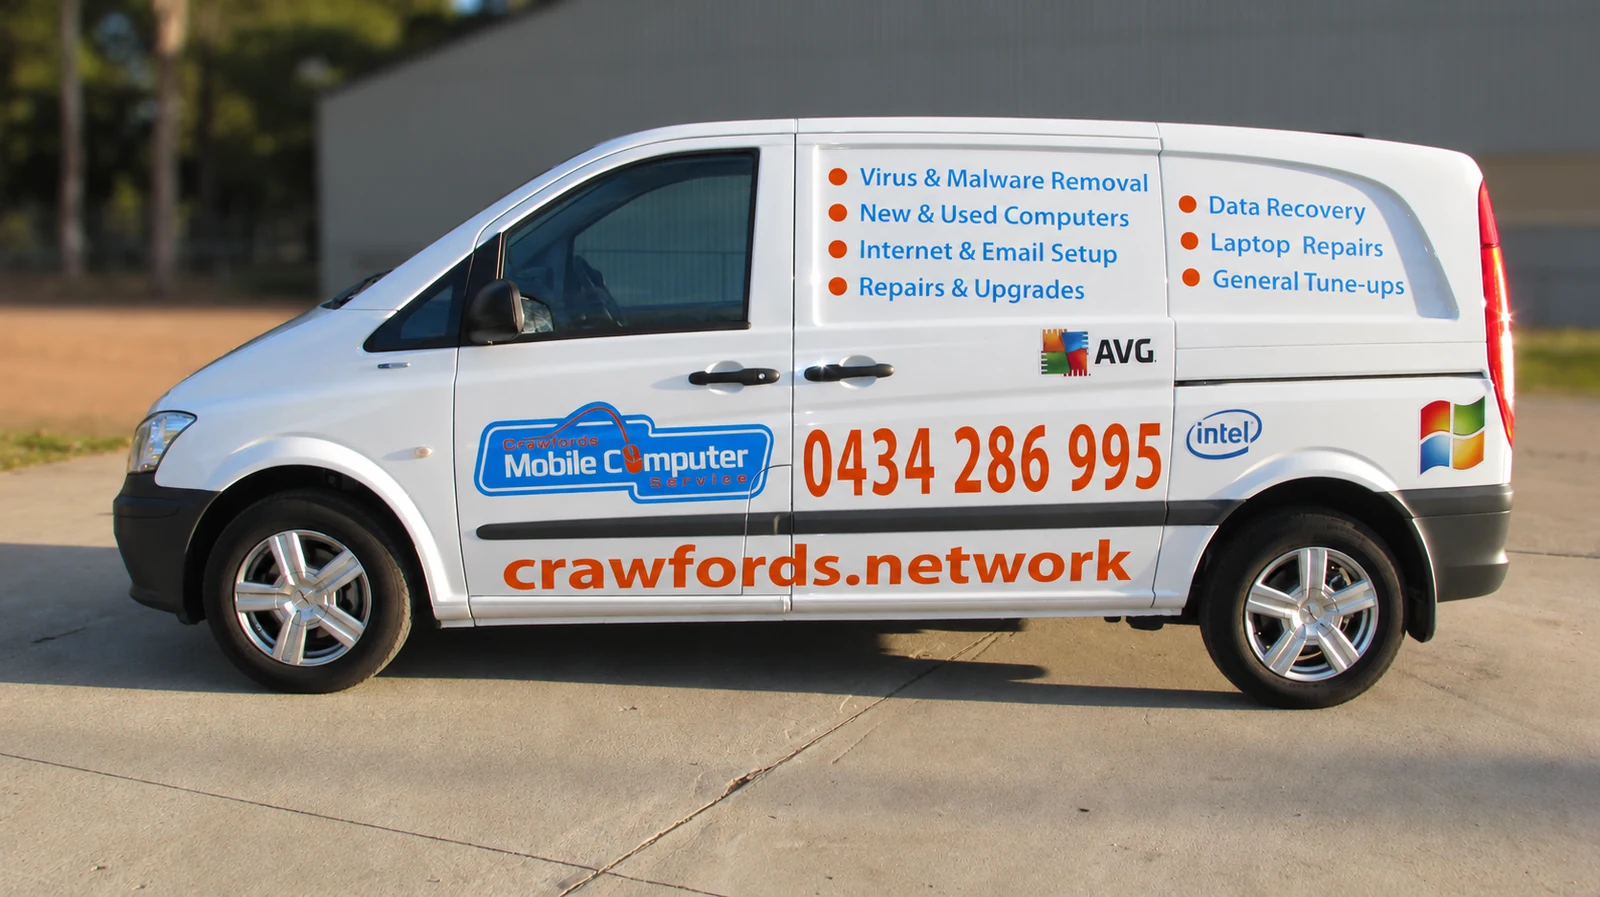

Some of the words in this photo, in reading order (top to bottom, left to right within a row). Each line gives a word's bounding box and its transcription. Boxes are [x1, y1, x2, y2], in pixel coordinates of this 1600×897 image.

[860, 168, 917, 187] Virus
[924, 168, 940, 187] &
[947, 169, 1044, 190] Malware
[1052, 171, 1148, 192] Removal
[860, 203, 911, 222] New
[918, 204, 934, 223] &
[941, 204, 997, 224] Used
[1004, 206, 1129, 230] Computers
[1210, 196, 1260, 216] Data
[1268, 198, 1366, 225] Recovery
[860, 240, 952, 260] Internet
[959, 242, 975, 260] &
[983, 242, 1044, 262] Email
[1052, 243, 1117, 268] Setup
[1212, 233, 1290, 258] Laptop
[1304, 236, 1383, 260] Repairs
[860, 276, 944, 302] Repairs
[952, 278, 968, 297] &
[975, 279, 1085, 304] Upgrades
[1213, 269, 1299, 291] General
[1304, 272, 1404, 299] Tune-ups
[1095, 339, 1153, 364] AVG
[503, 436, 599, 451] Crawfords
[1197, 420, 1248, 444] intel
[504, 449, 597, 478] Mobile
[804, 428, 934, 497] 0434
[955, 425, 1049, 493] 286
[1068, 423, 1161, 491] 995
[650, 474, 748, 488] Service
[504, 540, 1131, 590] crawfords.network
